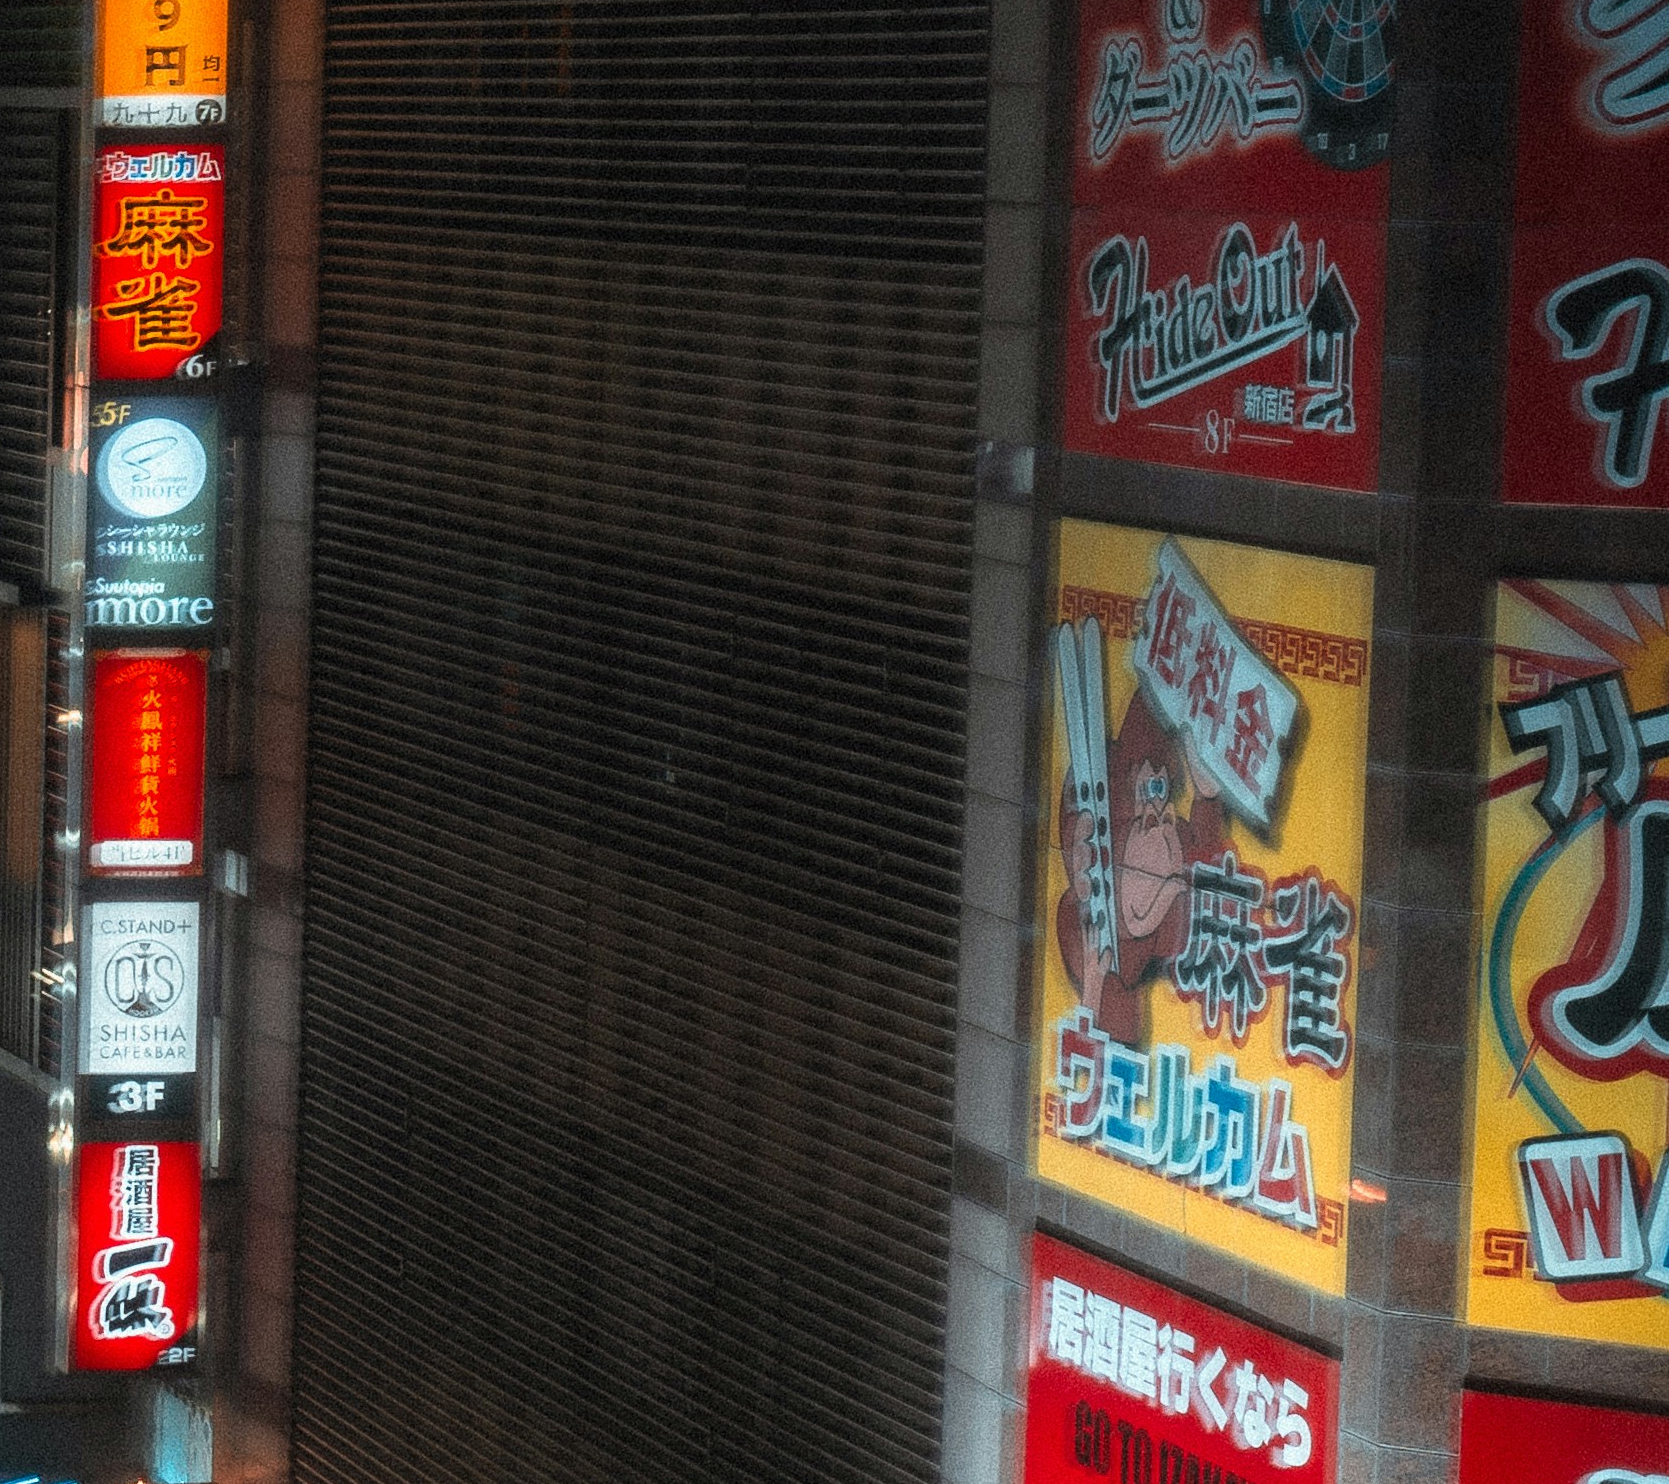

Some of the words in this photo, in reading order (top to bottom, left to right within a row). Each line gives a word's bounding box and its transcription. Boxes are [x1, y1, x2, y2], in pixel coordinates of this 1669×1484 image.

[201, 54, 222, 84] 均一
[111, 102, 188, 125] 九十九
[1090, 38, 1306, 164] ダーツバー
[98, 186, 215, 353] 麻雀
[184, 354, 218, 379] 6F
[98, 403, 132, 425] 5F
[1242, 382, 1296, 426] 新宿店
[1202, 408, 1235, 457] 8F
[129, 481, 189, 500] more
[105, 541, 191, 557] SHISHA
[90, 595, 216, 627] more
[1146, 569, 1280, 795] 低料金
[1175, 852, 1356, 1071] 麻雀
[100, 1023, 187, 1043] SHISHA
[99, 1044, 188, 1061] CAFE&BAR
[117, 1081, 166, 1112] 3F
[1052, 1006, 1318, 1229] ウェルカム
[121, 1145, 158, 1237] 居酒屋
[164, 1346, 197, 1364] 2F
[1047, 1274, 1313, 1467] 居酒屋行くなら
[1073, 1399, 1112, 1477] GO
